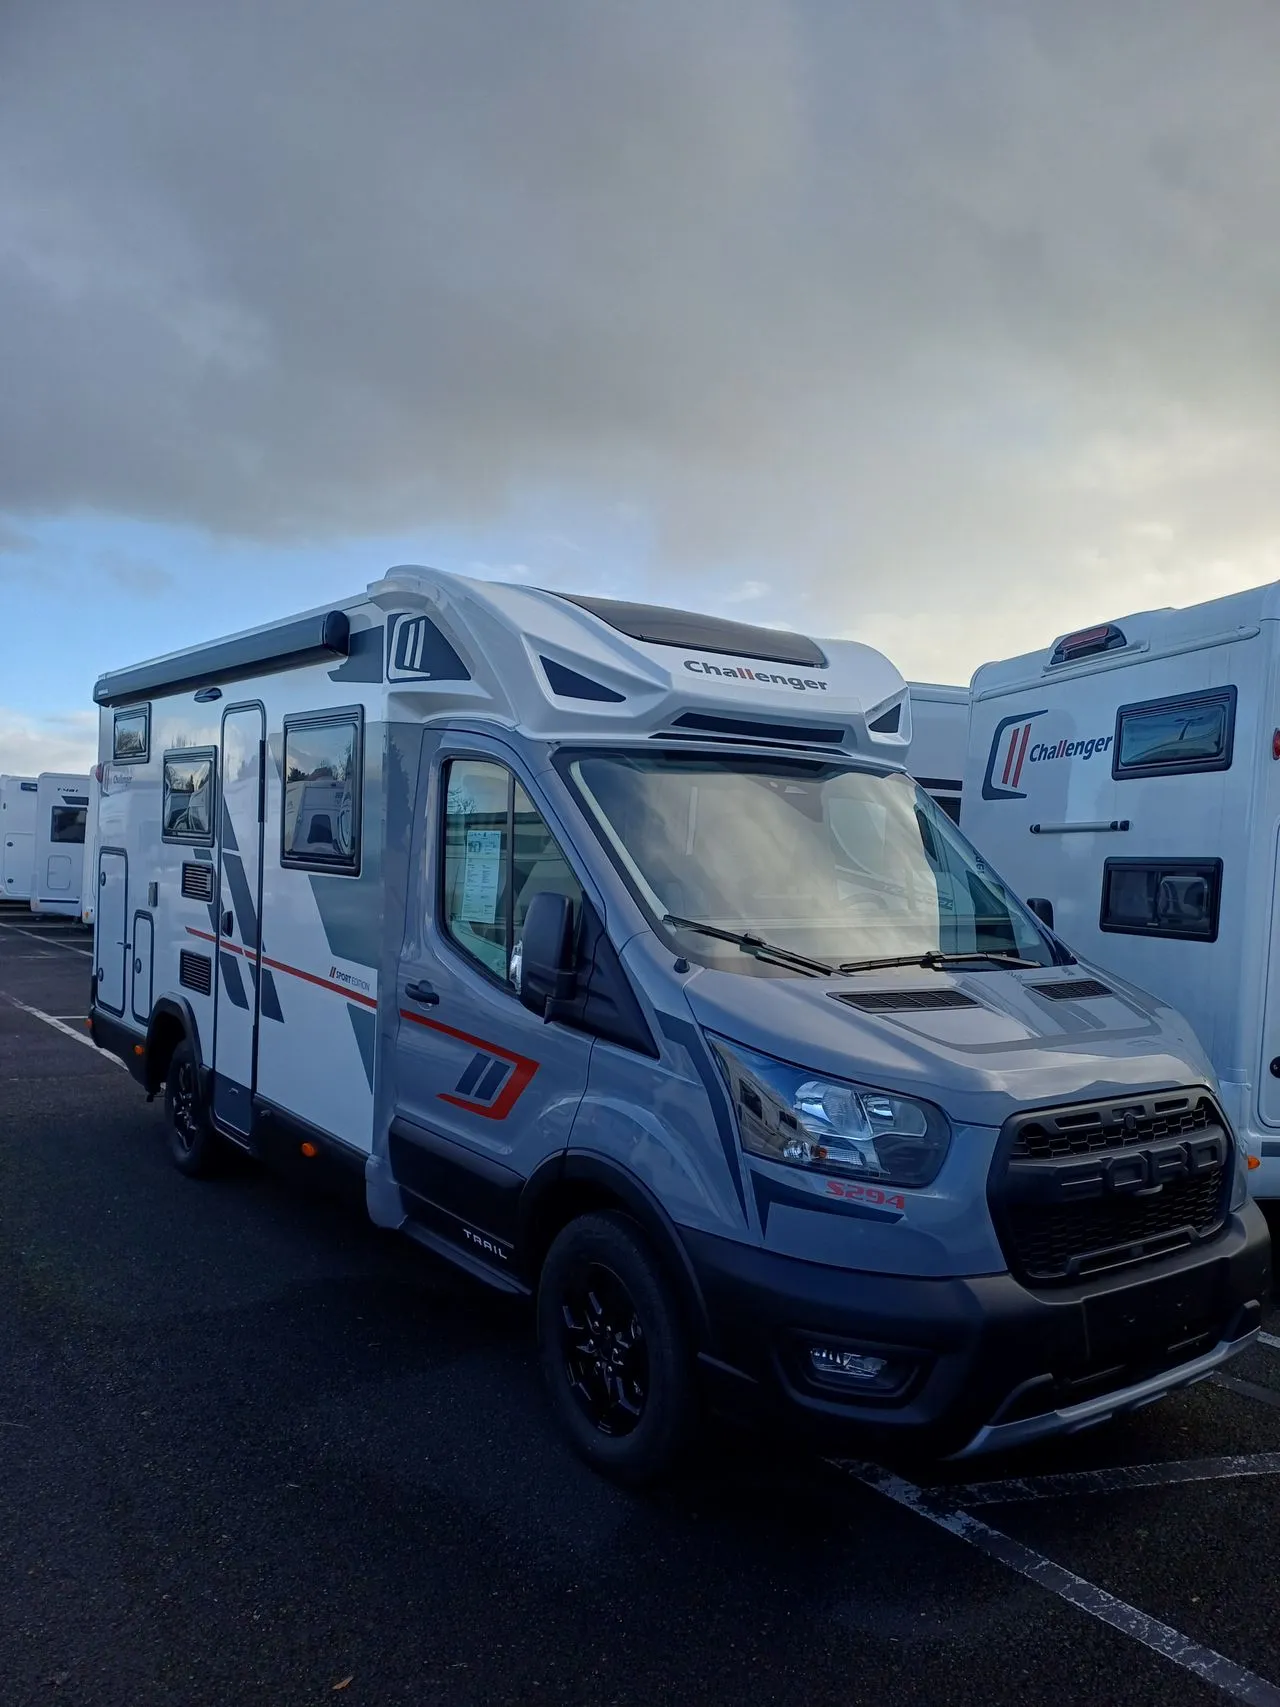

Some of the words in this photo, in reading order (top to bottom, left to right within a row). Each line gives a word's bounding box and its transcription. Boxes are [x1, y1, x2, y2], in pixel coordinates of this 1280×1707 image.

[683, 660, 829, 691] Challenger
[1029, 735, 1113, 762] Challenger
[336, 970, 352, 984] SPORT
[1055, 1137, 1225, 1201] FORD
[825, 1180, 905, 1210] S294
[463, 1228, 508, 1260] TRAIL
